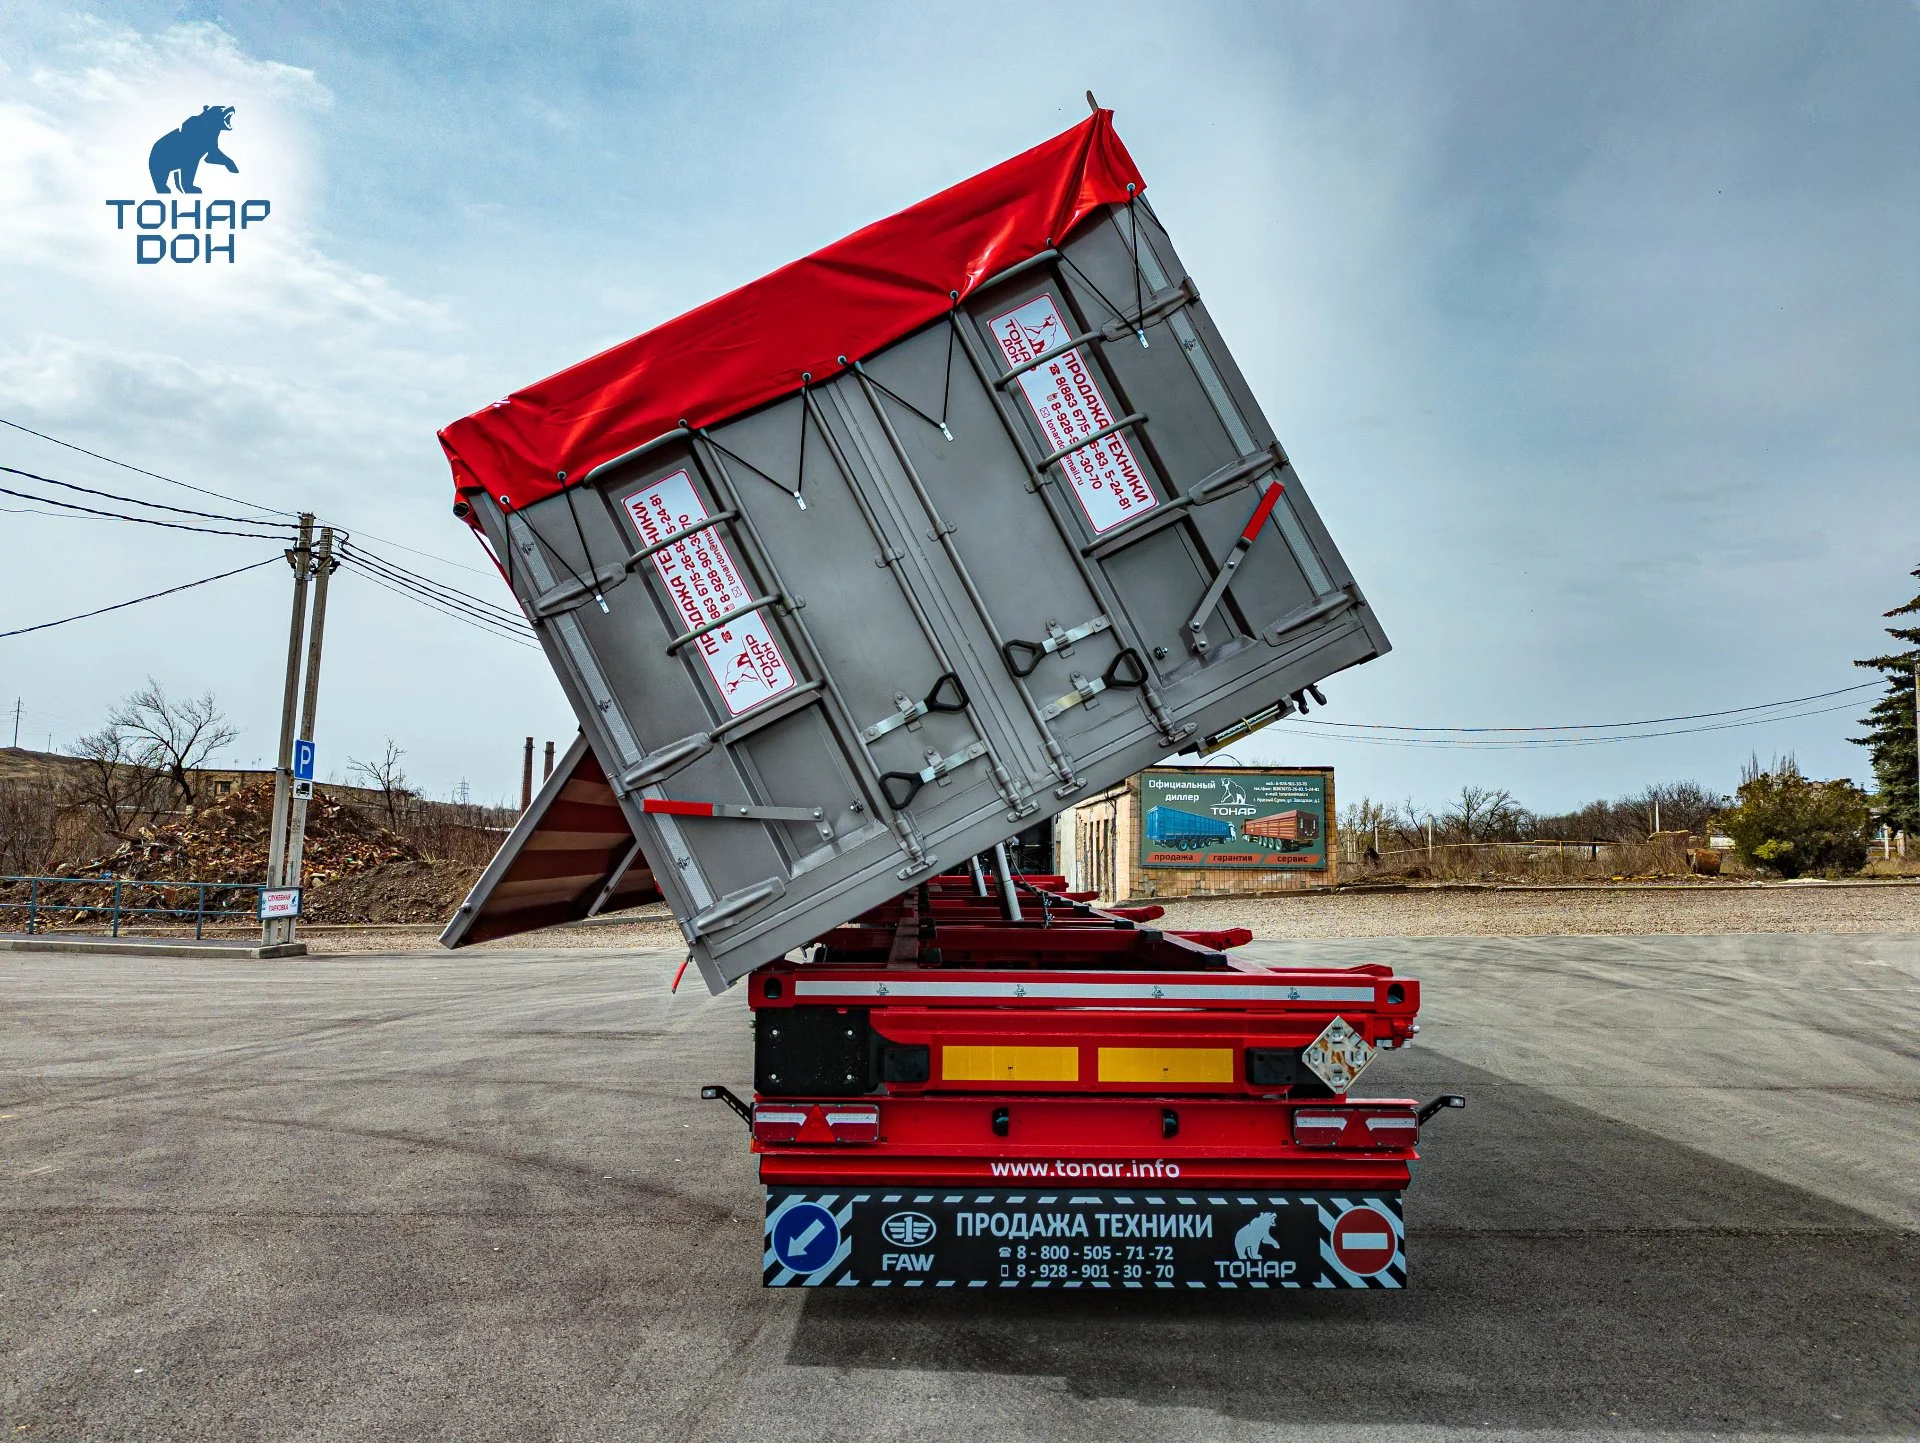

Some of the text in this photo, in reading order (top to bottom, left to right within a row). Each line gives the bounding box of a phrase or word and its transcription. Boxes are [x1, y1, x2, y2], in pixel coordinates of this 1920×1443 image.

[1001, 336, 1021, 363] ДОН
[1061, 350, 1148, 503] ПРОДАЖА ТЕХНИКИ
[1045, 418, 1085, 486] tonardo@mail.ru
[1053, 375, 1131, 510] 8(863 67)5-6-83, 5-24-81
[648, 493, 676, 535] 5-24-81
[677, 512, 731, 604] 8-928-901-3070
[744, 632, 779, 688] ТОНАР
[760, 641, 780, 669] ДОН
[1148, 780, 1216, 789] Официальный
[1165, 794, 1200, 803] диллер
[1210, 807, 1257, 816] ТОНАР
[1154, 854, 1308, 863] продажа гарантия сервис
[990, 1159, 1180, 1178] www.tonar.info
[956, 1212, 1213, 1240] ПРОДАЖА ТЕХНИКИ
[882, 1254, 935, 1271] FAW
[1214, 1261, 1297, 1278] ТОНАР
